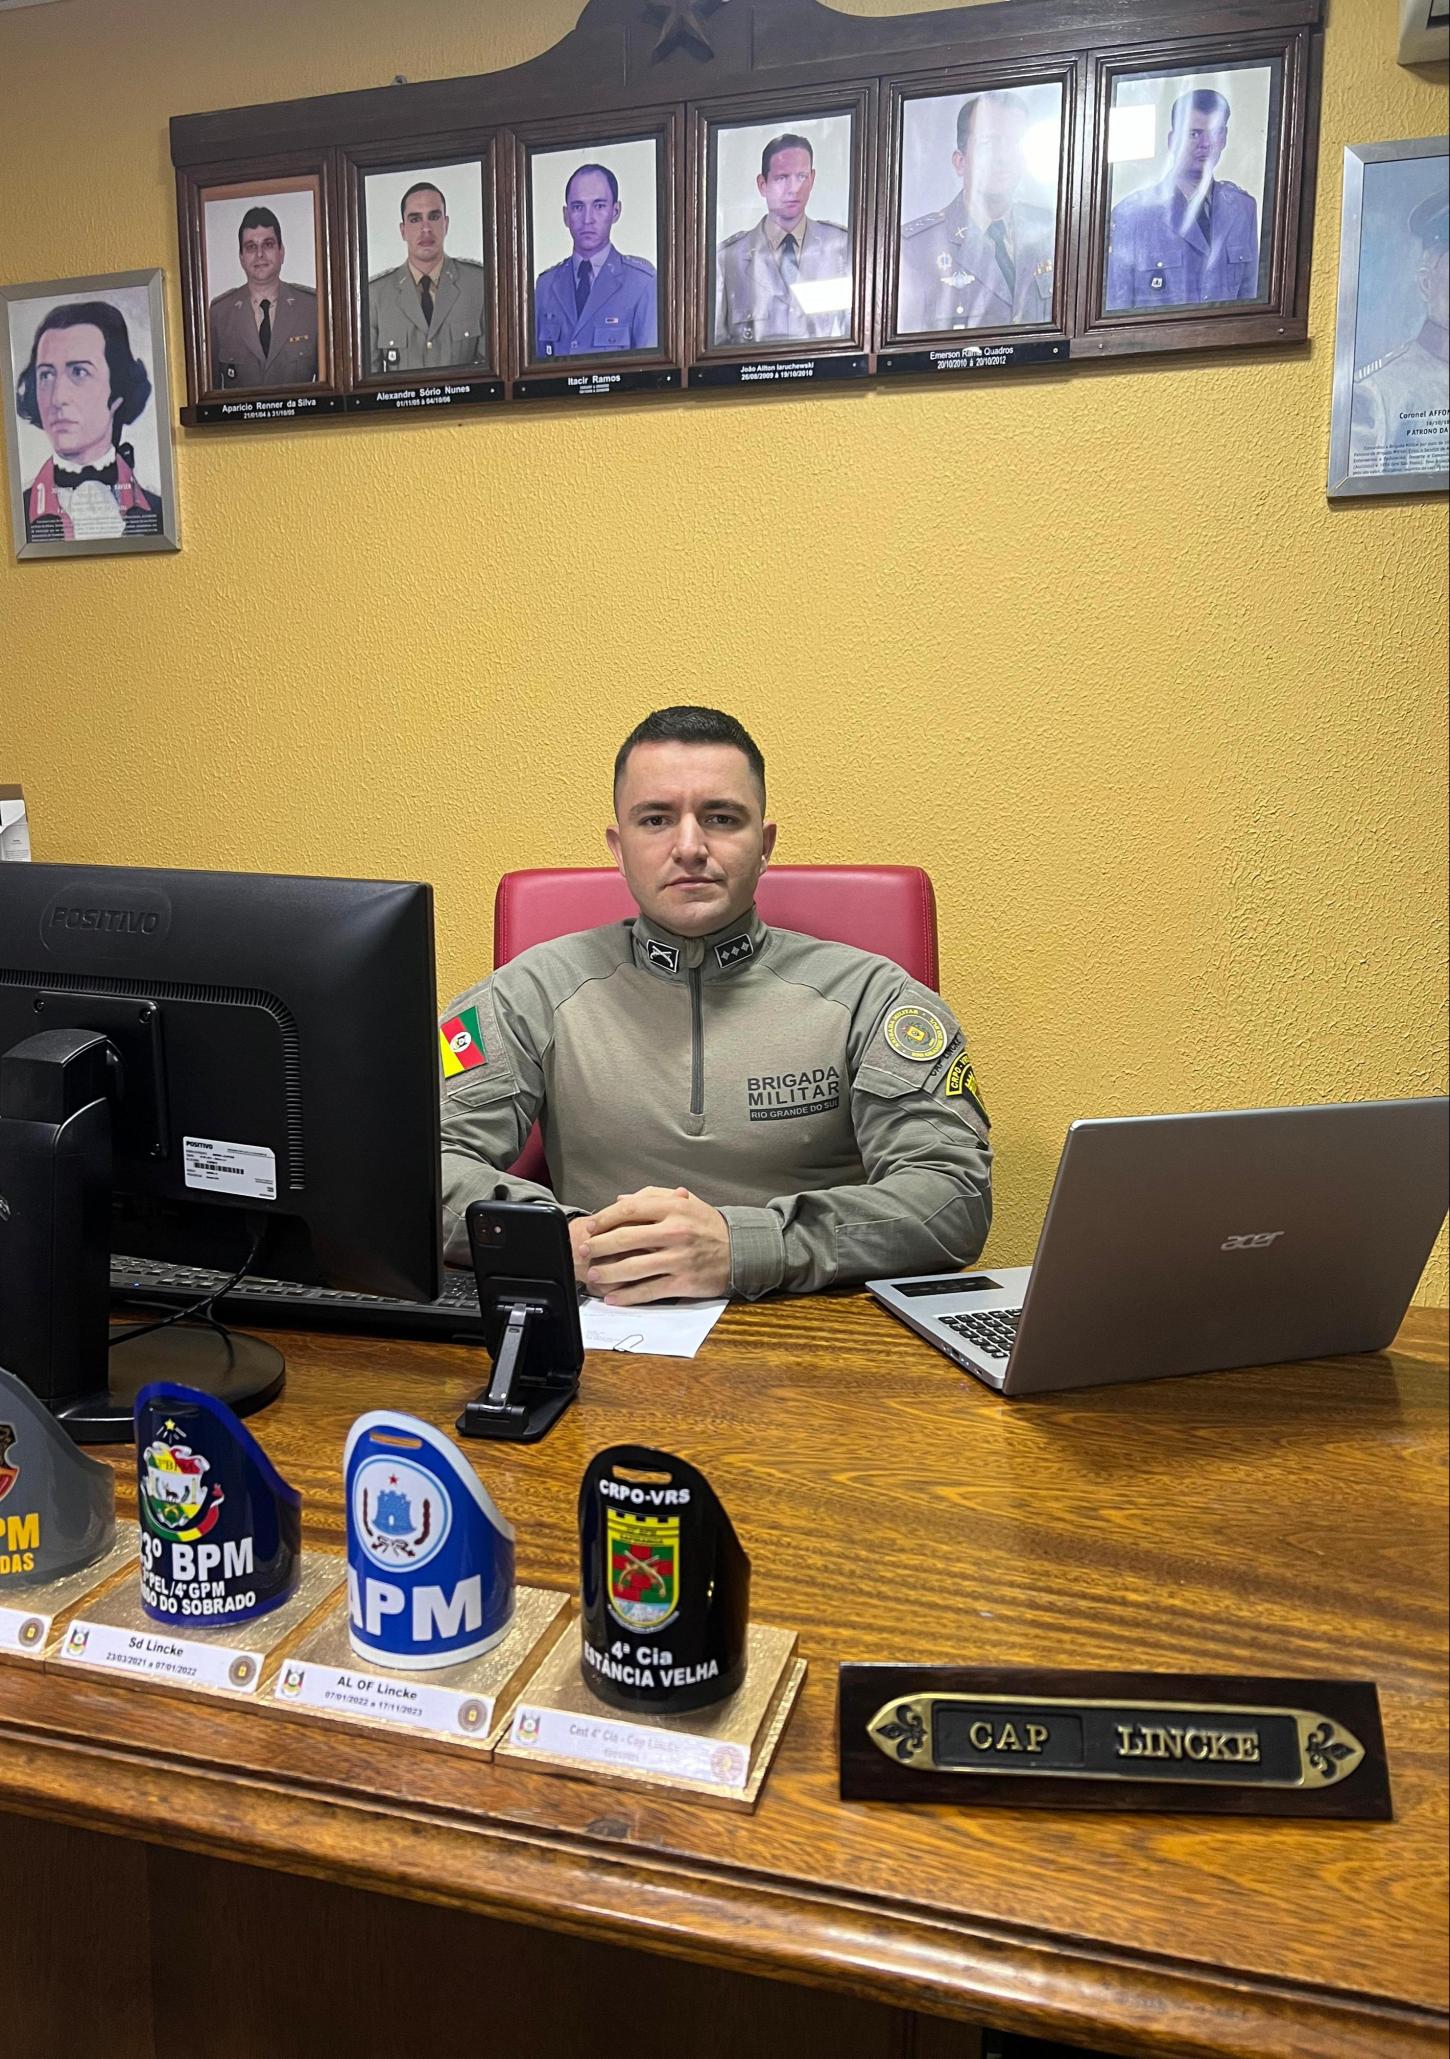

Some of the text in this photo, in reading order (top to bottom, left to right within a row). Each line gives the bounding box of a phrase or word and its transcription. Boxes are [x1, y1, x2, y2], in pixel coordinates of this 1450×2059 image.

[930, 351, 960, 360] Emerson
[984, 346, 1014, 356] Quadros
[568, 376, 589, 386] Itacir
[592, 374, 621, 384] Ramos
[376, 385, 470, 401] Alexandre Sório Nunes
[256, 401, 283, 410] Renner
[286, 400, 296, 408] da
[297, 398, 317, 407] Silva
[1399, 410, 1427, 419] Coronel
[1406, 427, 1438, 436] PATRONO
[48, 906, 160, 935] POSITIVO
[747, 1066, 840, 1091] BRIGADA
[748, 1081, 840, 1106] MILITAR
[751, 1111, 768, 1119] RIO
[769, 1106, 809, 1118] GRANDE
[810, 1104, 822, 1112] DO
[186, 1140, 213, 1150] POSITIVO
[599, 1479, 691, 1506] CRPO-VRS
[171, 1536, 254, 1582] BPM
[159, 1595, 178, 1614] DO
[181, 1591, 256, 1616] SOBRADO
[128, 1637, 184, 1657] Sd Lincke
[636, 1646, 673, 1666] Cia
[660, 1659, 719, 1687] VELHA
[337, 1676, 418, 1700] AL OF Lincke
[969, 1720, 1261, 1763] CAP LINCKE
